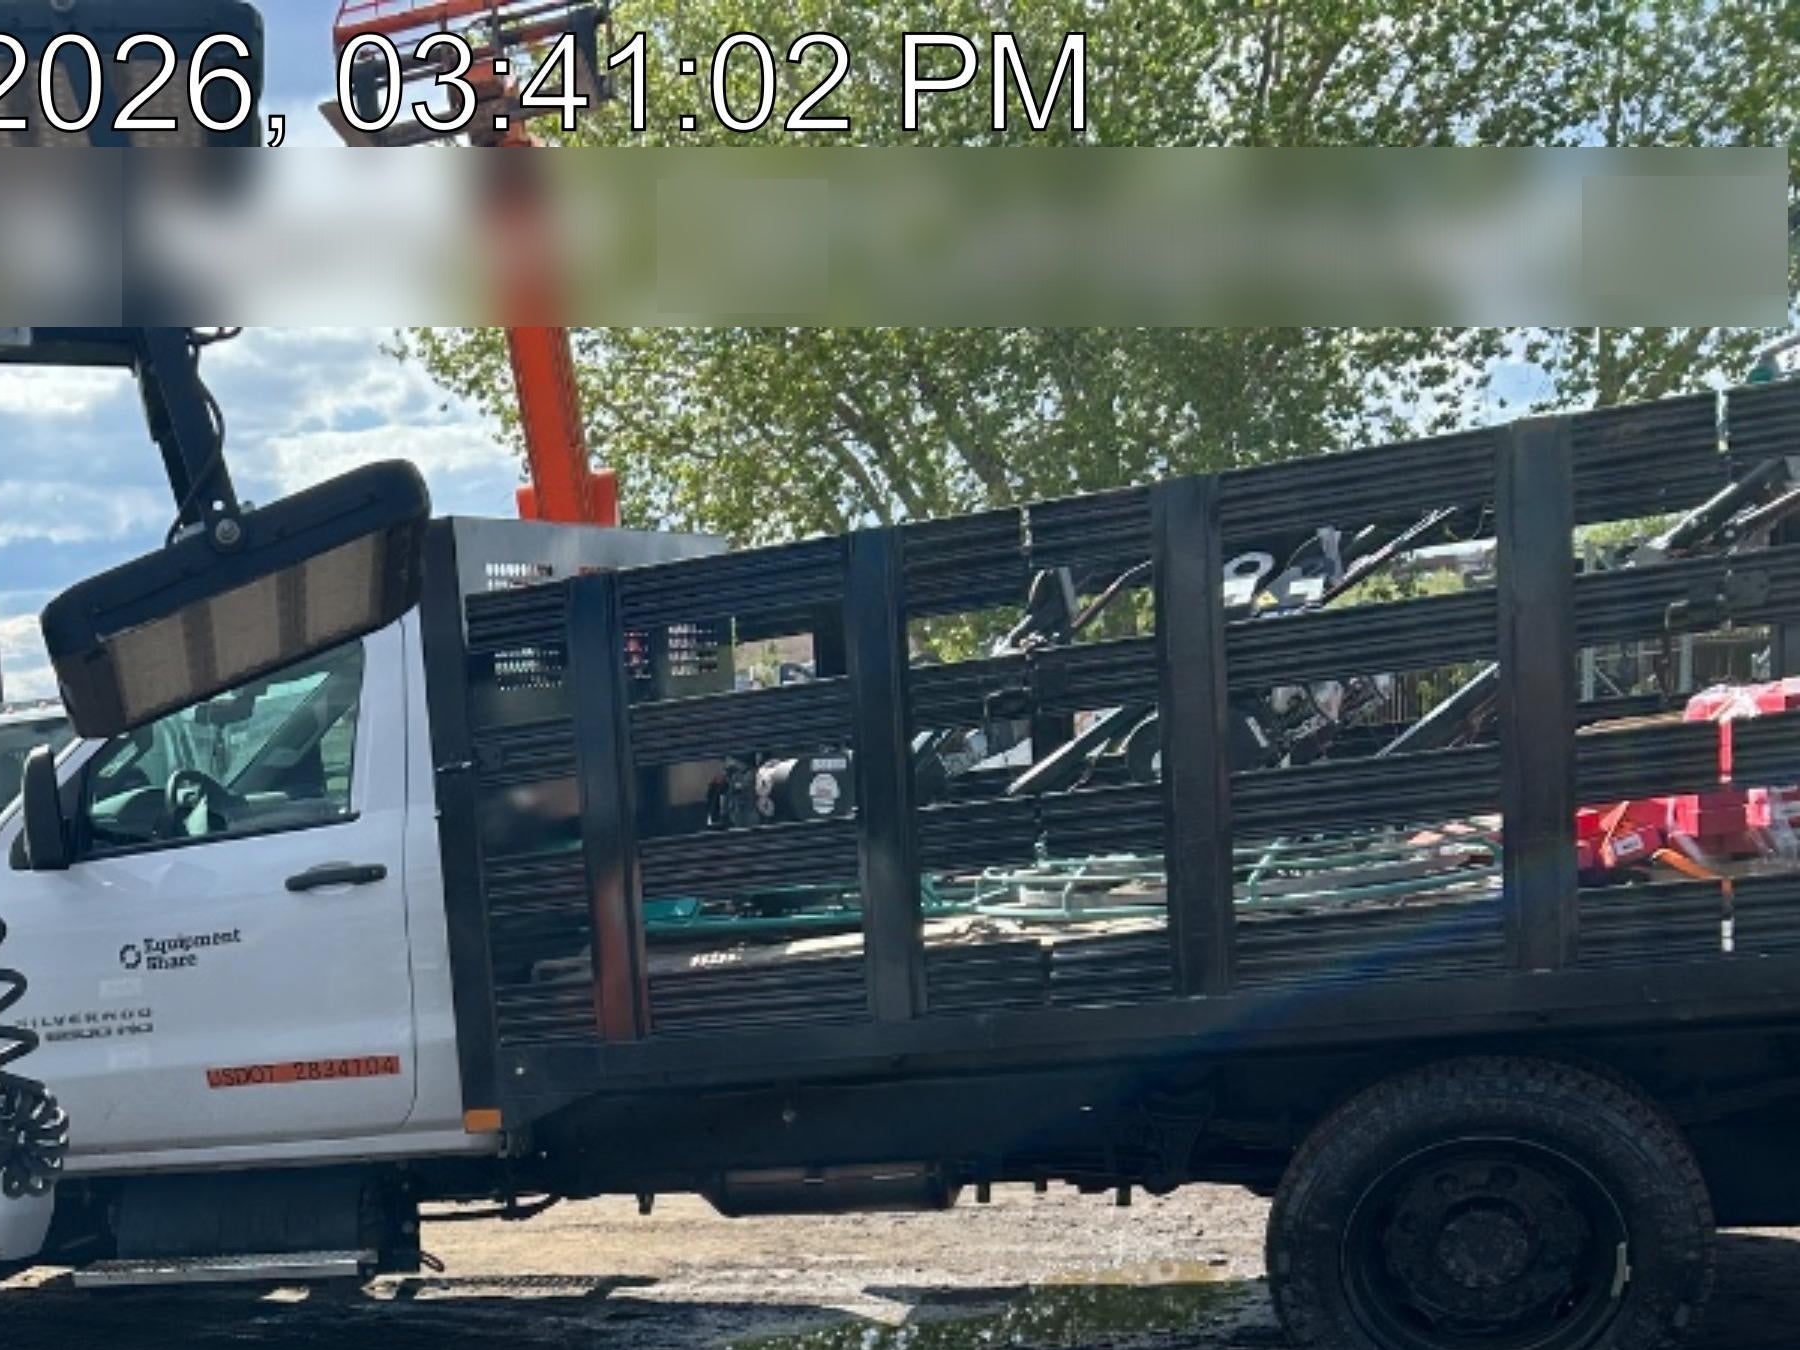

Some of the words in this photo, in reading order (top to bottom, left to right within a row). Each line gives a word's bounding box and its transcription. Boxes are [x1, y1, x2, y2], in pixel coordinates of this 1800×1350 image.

[144, 928, 241, 954] Equipment
[146, 953, 198, 971] Share
[206, 1064, 277, 1089] USDOT
